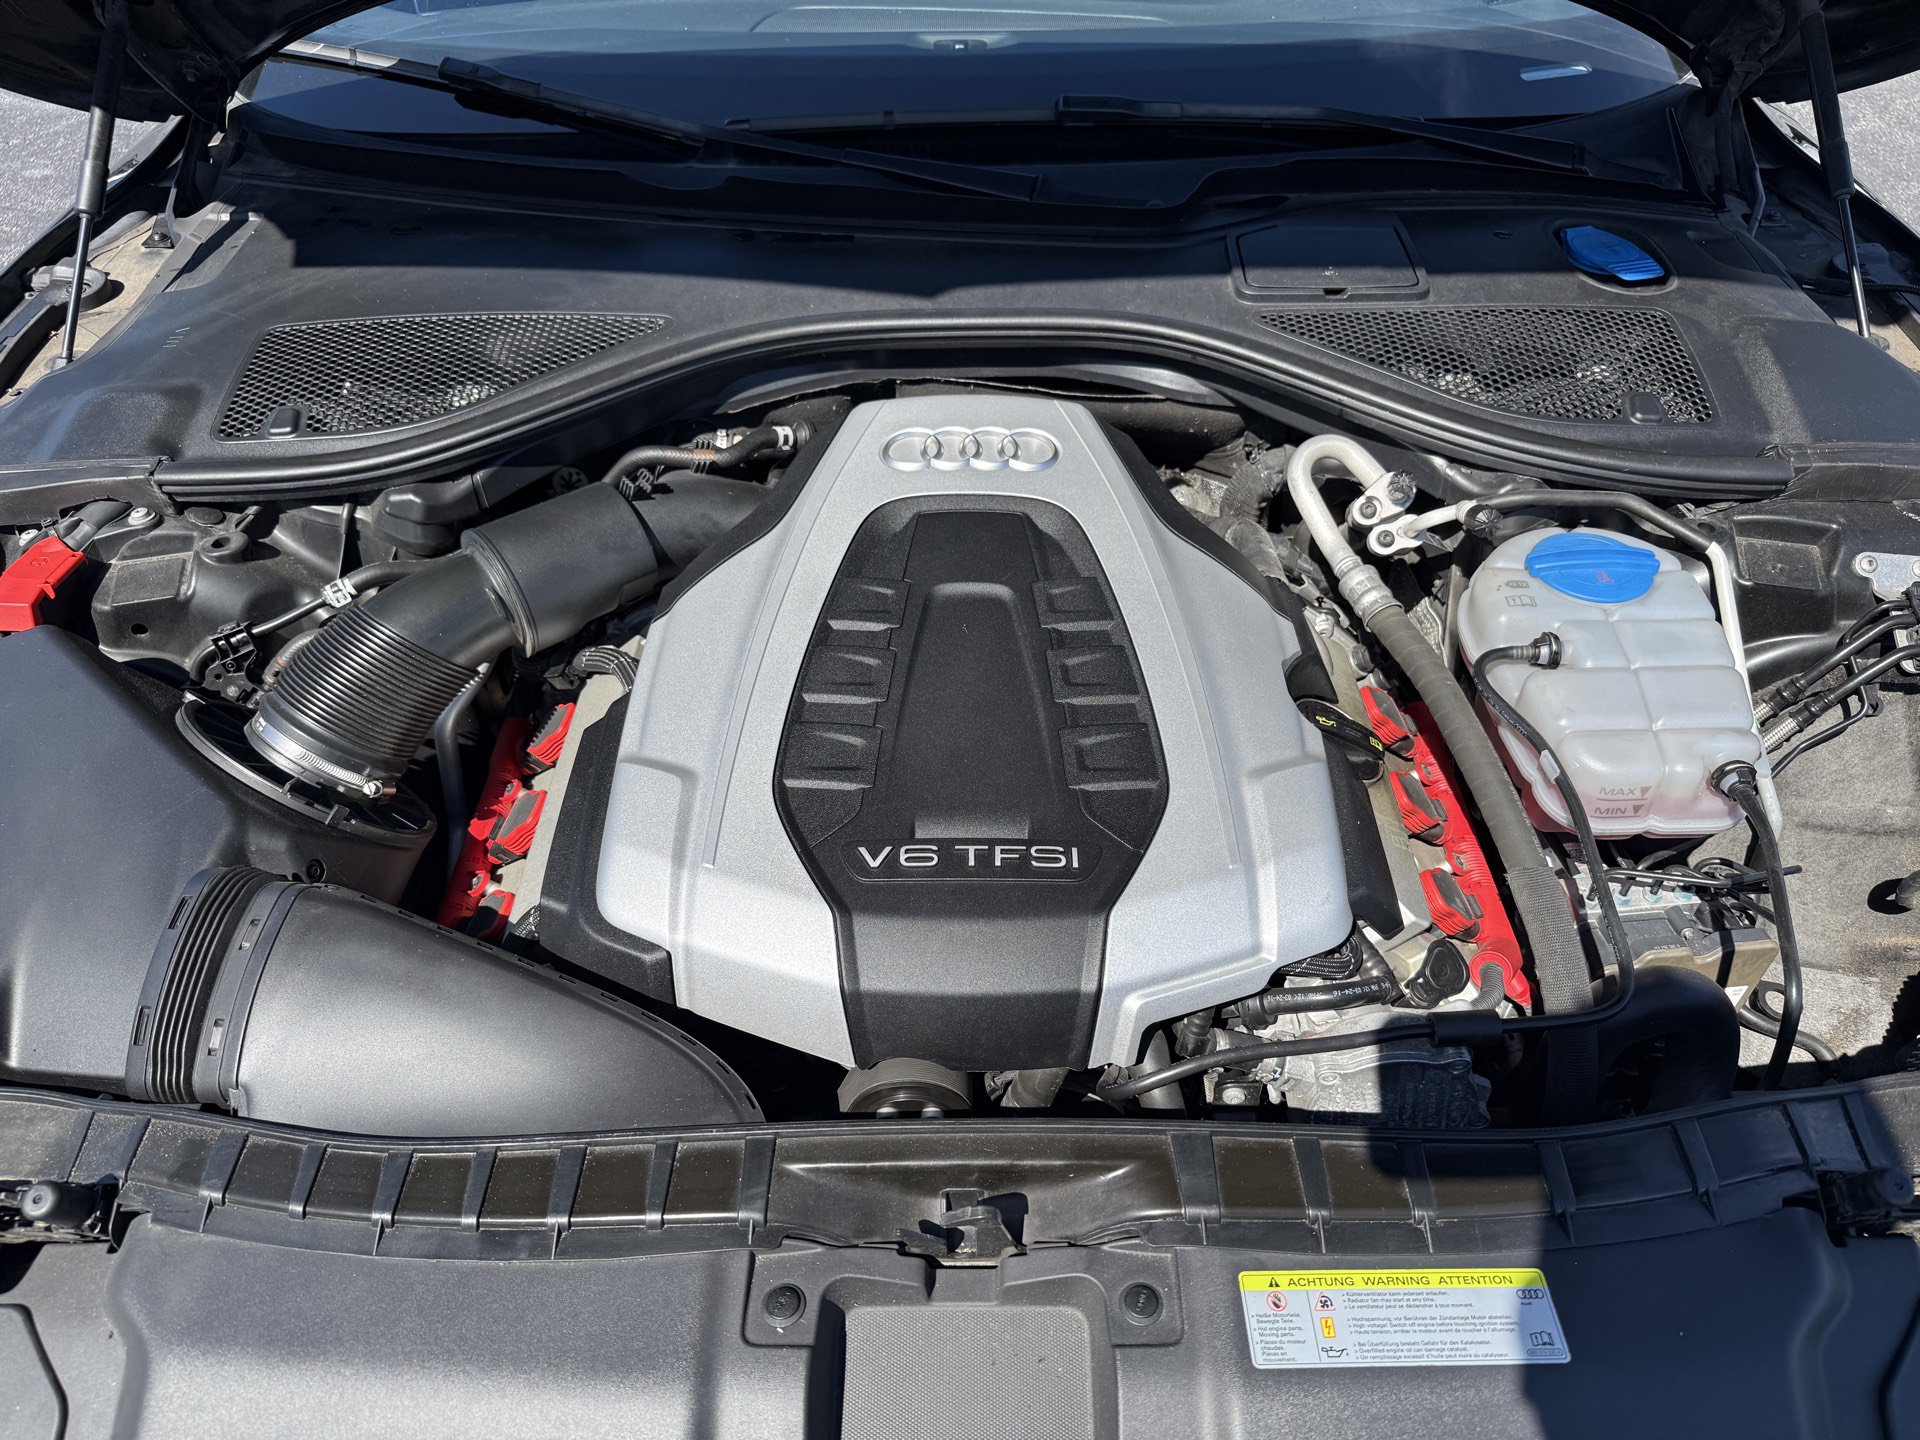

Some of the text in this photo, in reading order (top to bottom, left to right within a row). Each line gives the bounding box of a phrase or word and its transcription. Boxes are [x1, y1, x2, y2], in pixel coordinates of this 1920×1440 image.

[1600, 788, 1638, 796] MAX
[1594, 807, 1627, 815] MIN
[857, 845, 1079, 868] V6 TFSI
[1288, 1275, 1514, 1287] ACHTUNG WARNING ATTENTION
